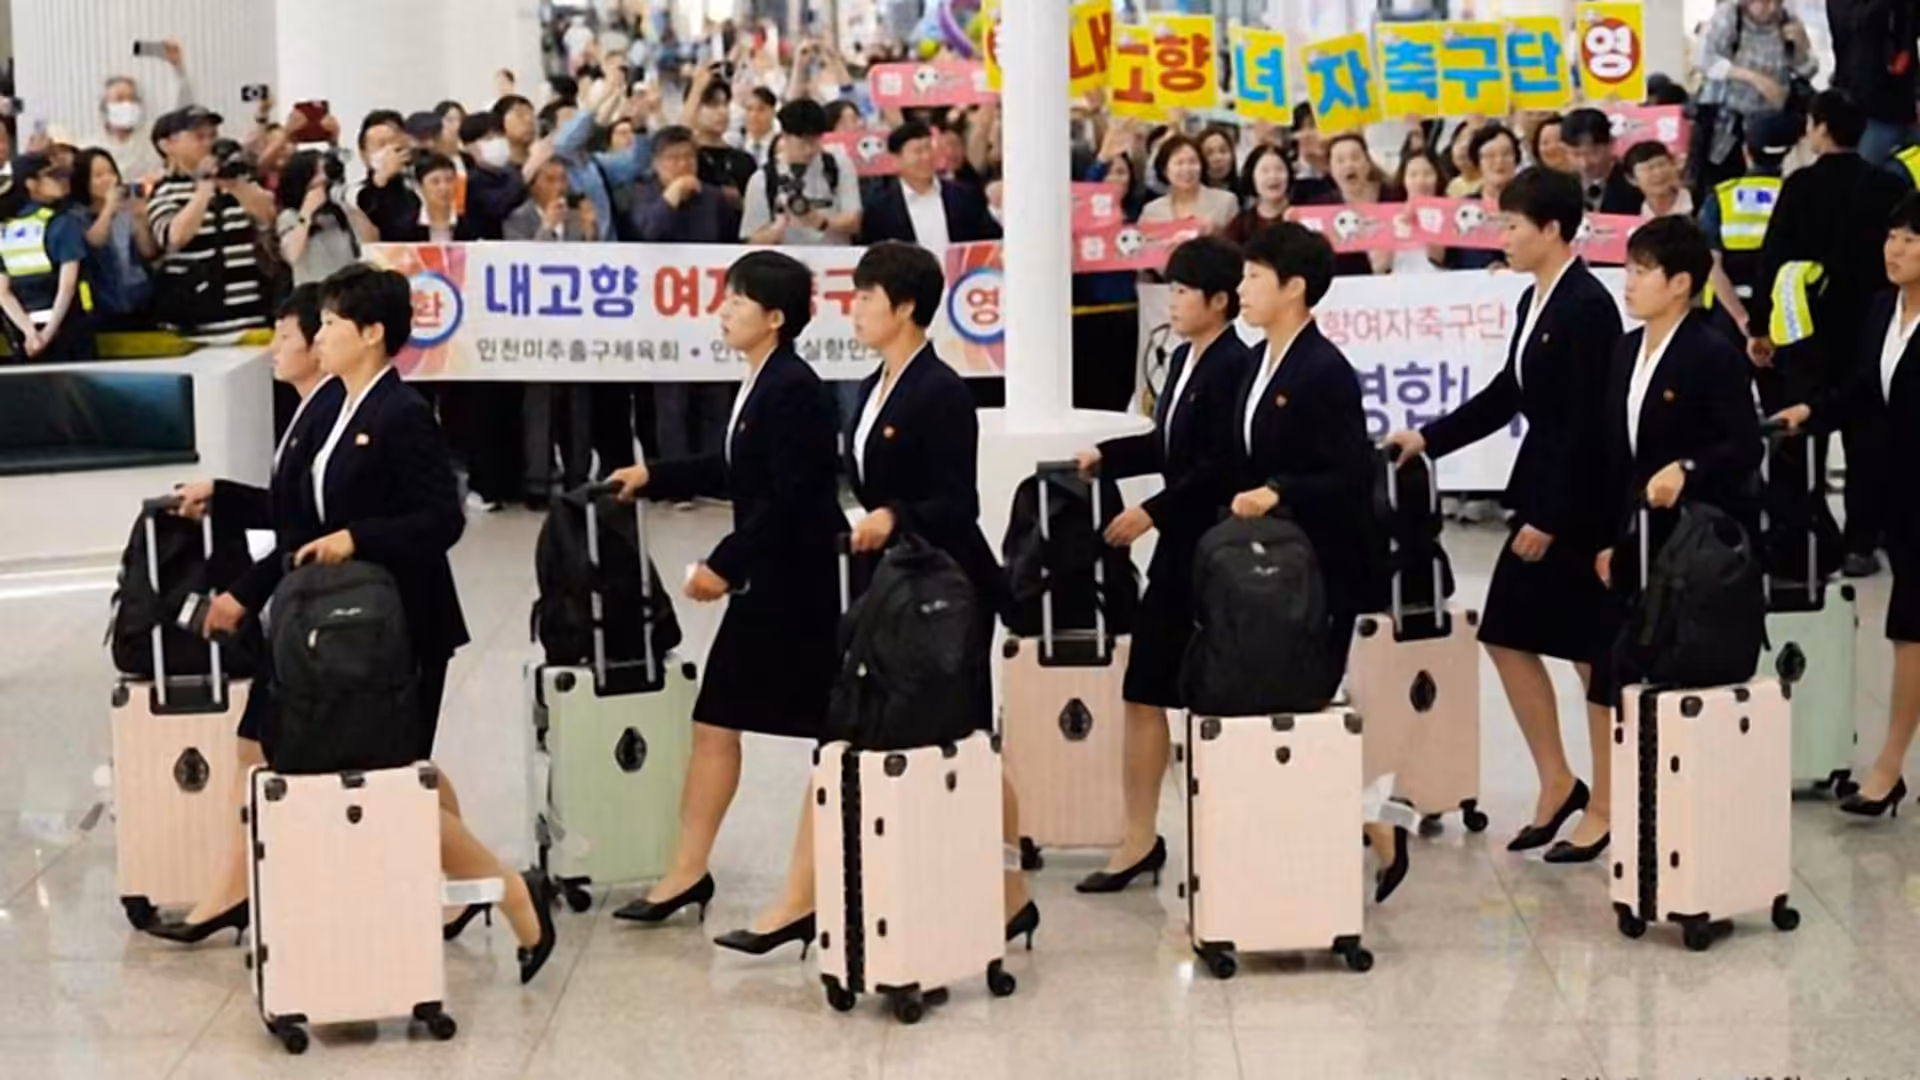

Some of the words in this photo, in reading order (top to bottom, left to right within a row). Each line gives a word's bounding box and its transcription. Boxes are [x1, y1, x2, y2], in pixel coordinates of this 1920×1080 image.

[1584, 25, 1633, 78] 영
[485, 262, 639, 318] 내고향
[966, 287, 1001, 326] 영
